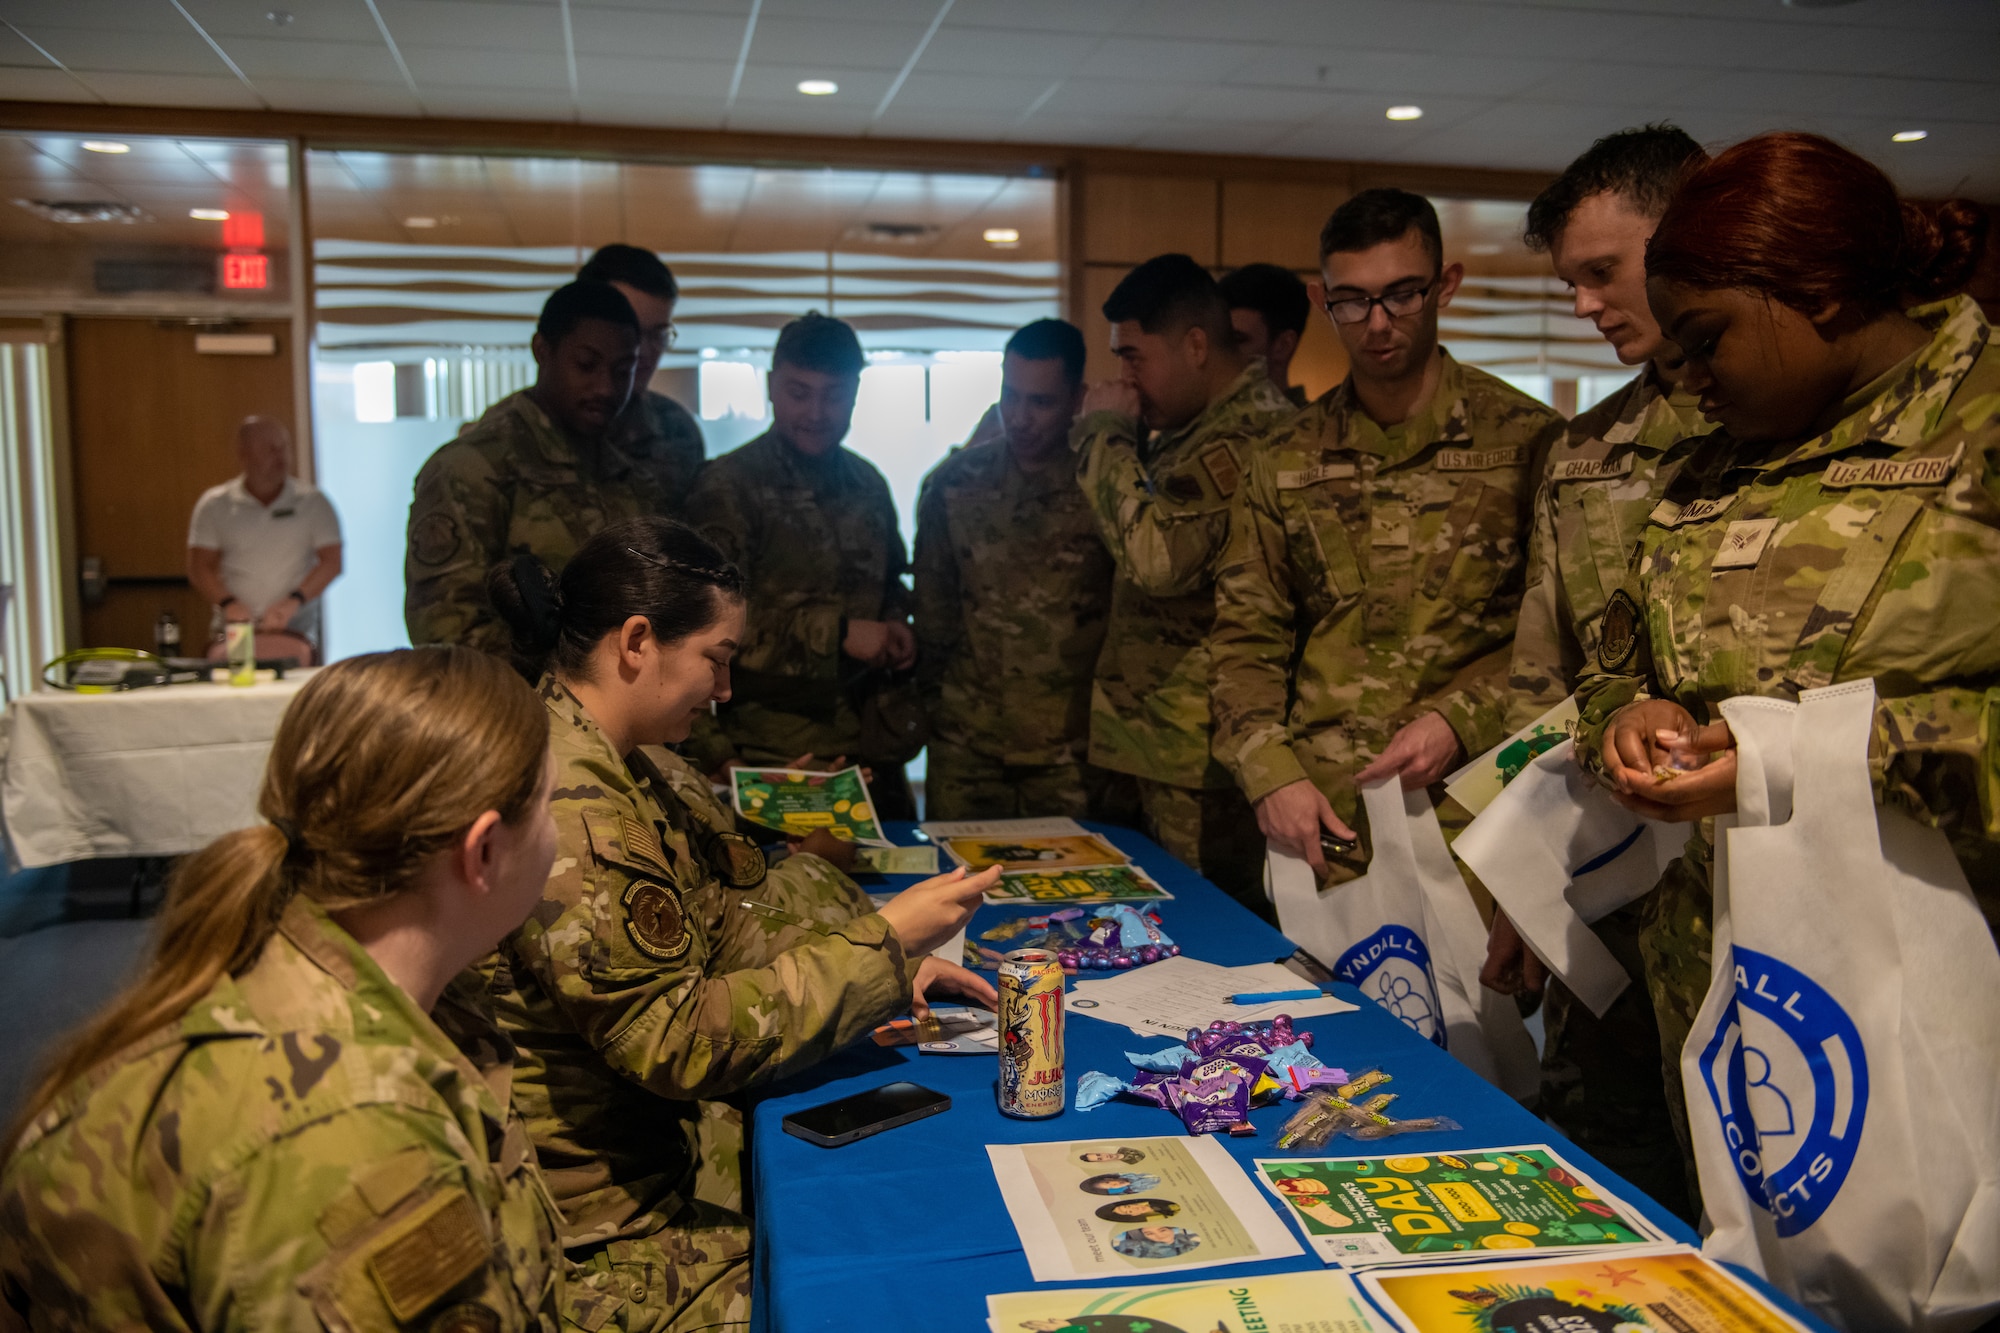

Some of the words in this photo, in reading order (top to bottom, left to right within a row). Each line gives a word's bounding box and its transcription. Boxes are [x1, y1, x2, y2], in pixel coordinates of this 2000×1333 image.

[225, 257, 266, 287] EXIT
[1464, 452, 1484, 467] AIR
[1486, 447, 1526, 465] FORCE
[1565, 458, 1622, 477] CHAPMAN
[1861, 462, 1899, 481] AIR
[1341, 934, 1418, 979] YNDALL
[1032, 965, 1057, 976] PACIFIC
[1025, 1100, 1057, 1108] ENERGY
[1340, 1182, 1382, 1218] PATRICK'S
[1354, 1176, 1453, 1236] DAY
[1077, 1218, 1091, 1233] team
[1372, 1218, 1393, 1233] ST.
[1083, 1233, 1097, 1244] our
[1089, 1244, 1105, 1263] meet
[1228, 1287, 1268, 1333] EETING
